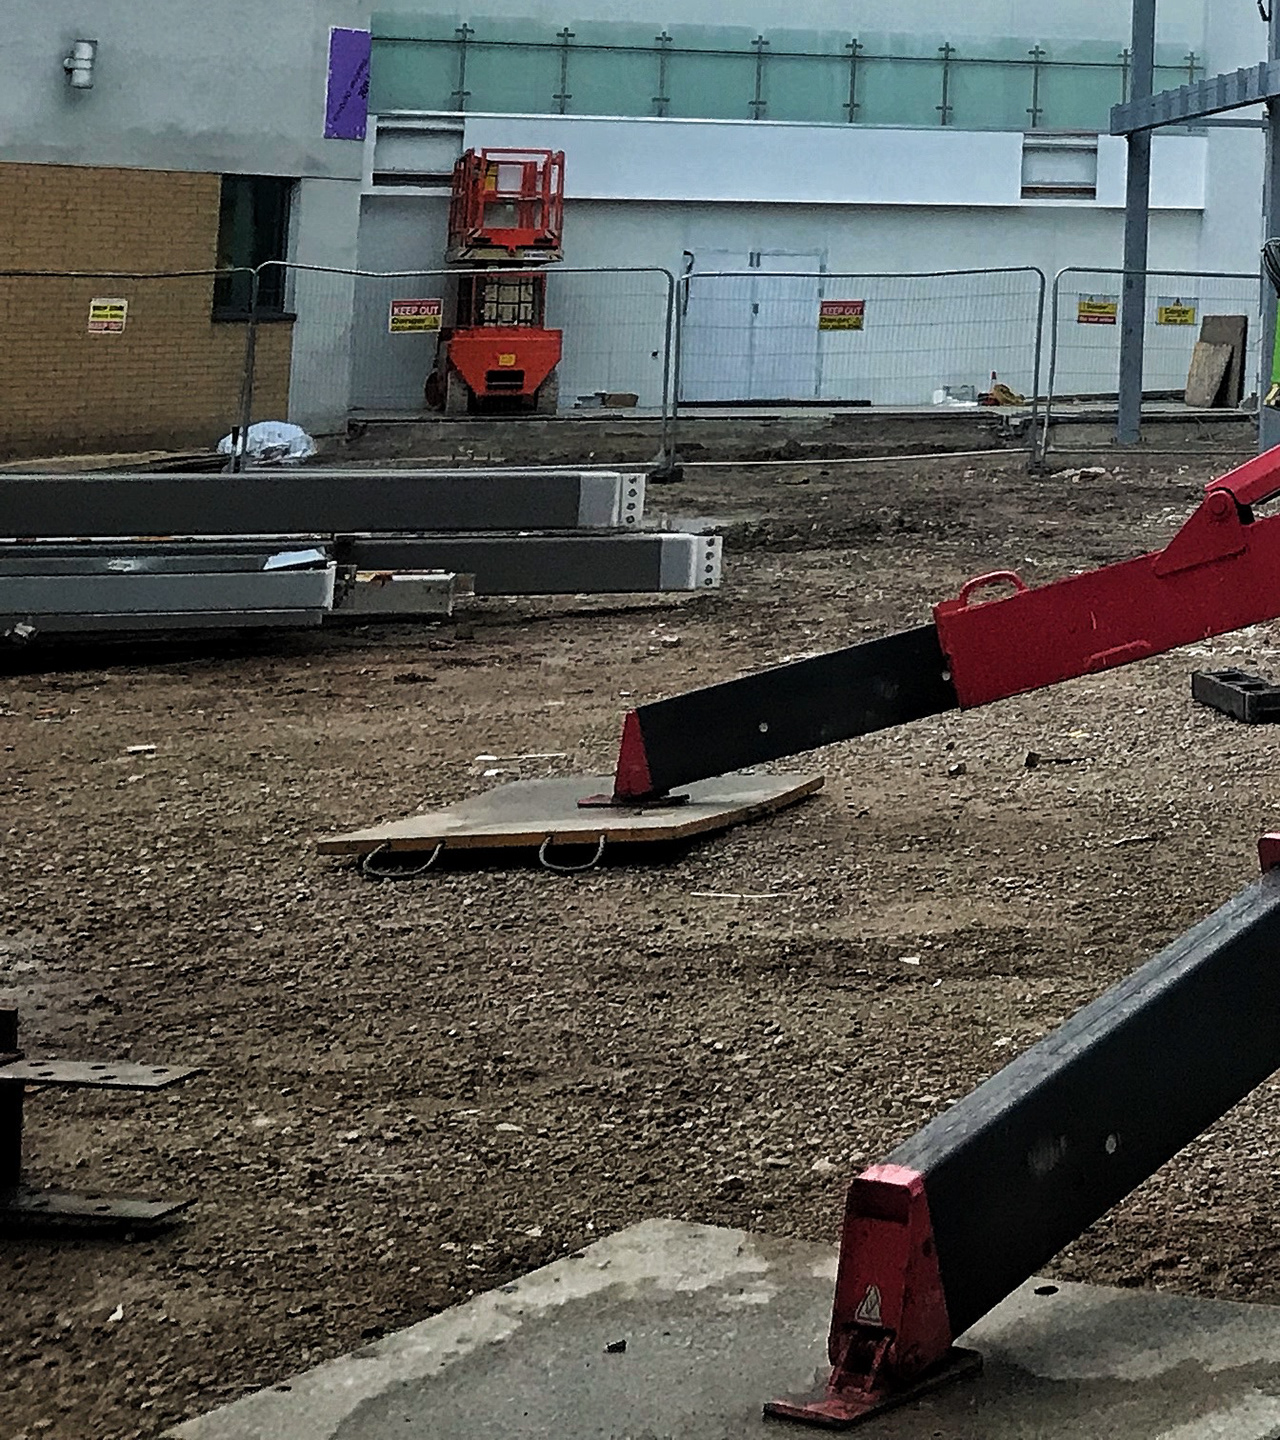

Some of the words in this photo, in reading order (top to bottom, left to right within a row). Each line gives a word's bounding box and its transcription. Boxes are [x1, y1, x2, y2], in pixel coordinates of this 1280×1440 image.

[393, 306, 419, 315] KEEP
[420, 306, 439, 315] OUT
[822, 307, 844, 315] KEEP
[845, 307, 862, 315] OUT
